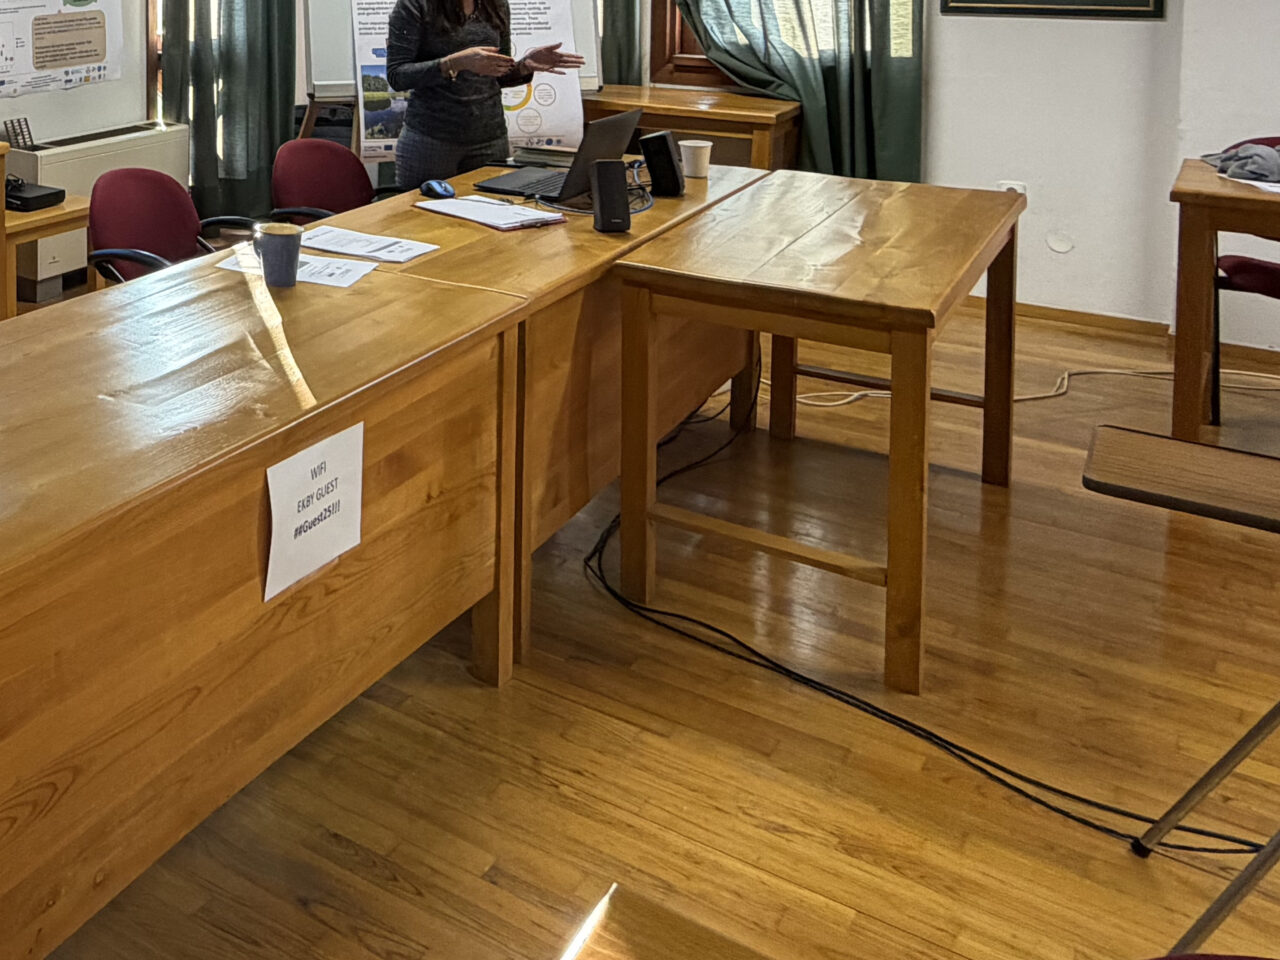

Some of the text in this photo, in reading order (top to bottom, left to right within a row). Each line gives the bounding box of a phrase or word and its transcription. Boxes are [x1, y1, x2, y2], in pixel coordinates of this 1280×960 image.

[310, 461, 327, 480] WIFI
[297, 477, 339, 513] EKBY GUEST
